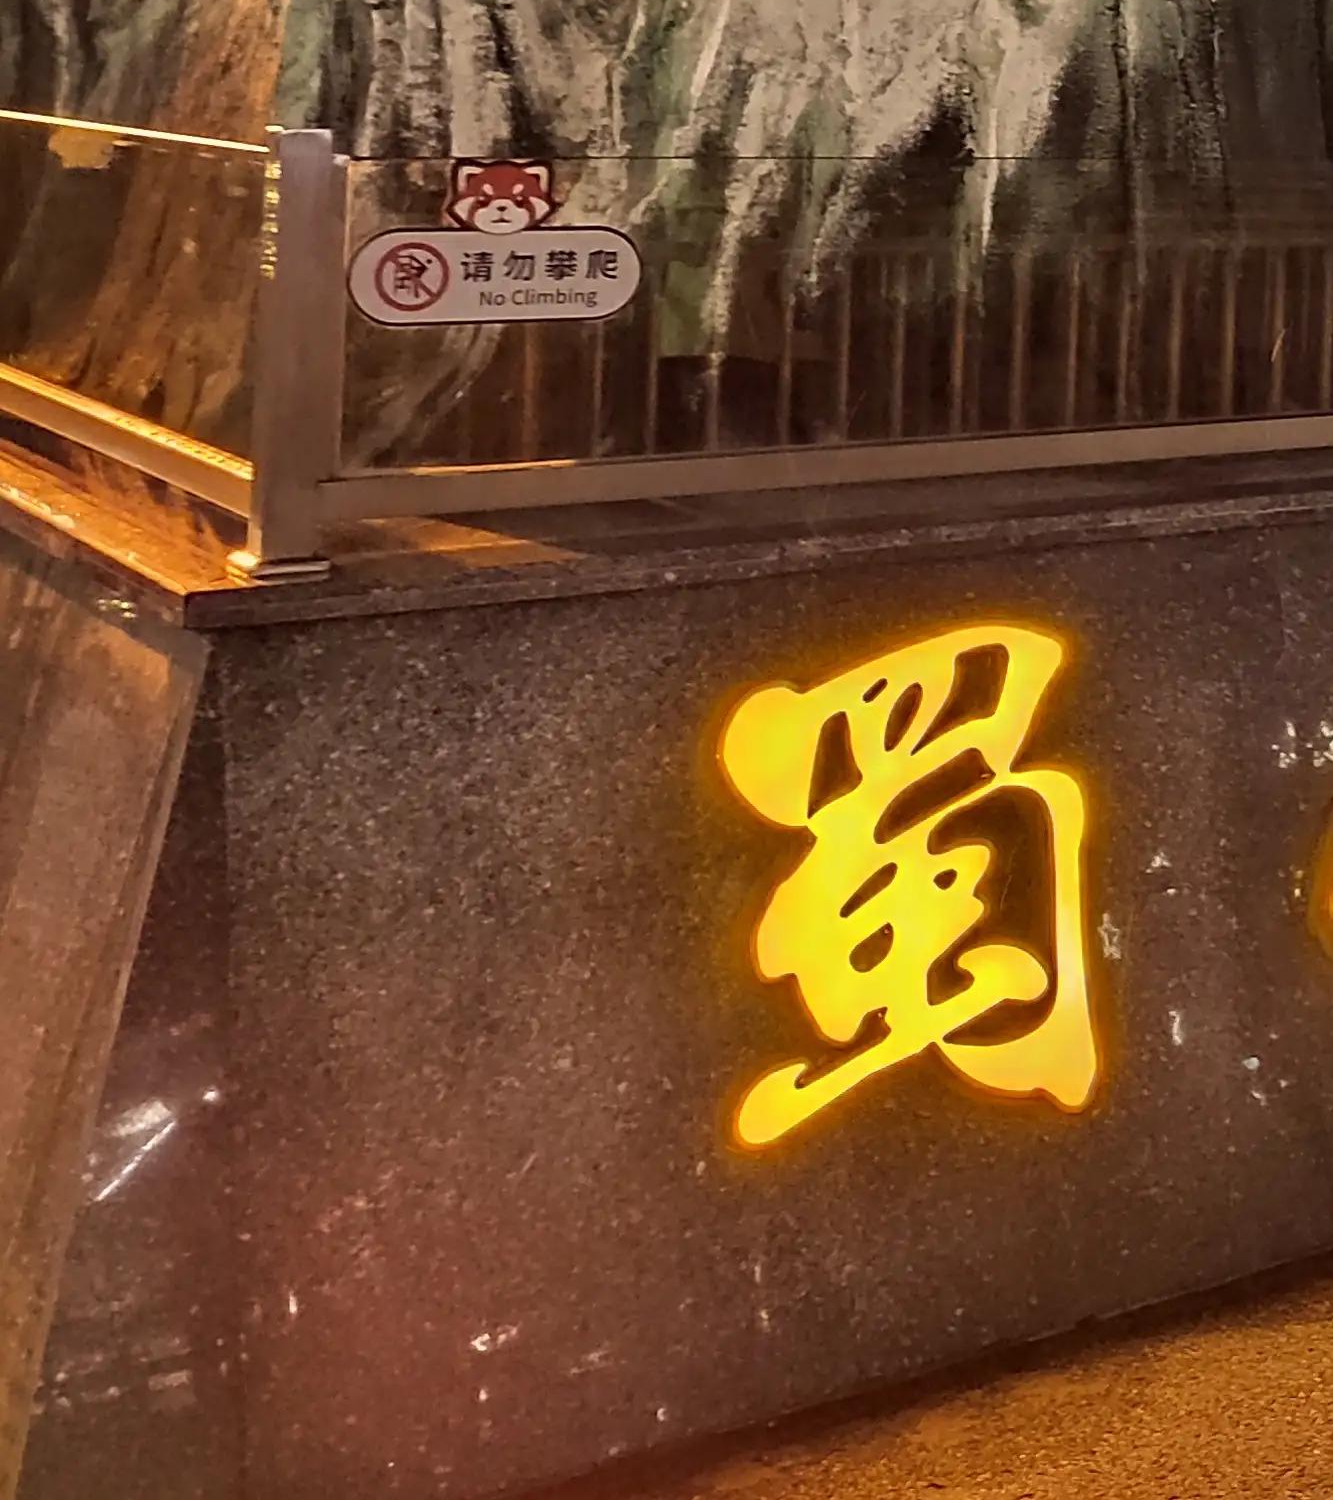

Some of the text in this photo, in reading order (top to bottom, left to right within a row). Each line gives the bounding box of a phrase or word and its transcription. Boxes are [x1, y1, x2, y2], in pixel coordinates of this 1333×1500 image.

[460, 249, 619, 282] 请勿攀爬
[479, 288, 598, 308] No Climbing
